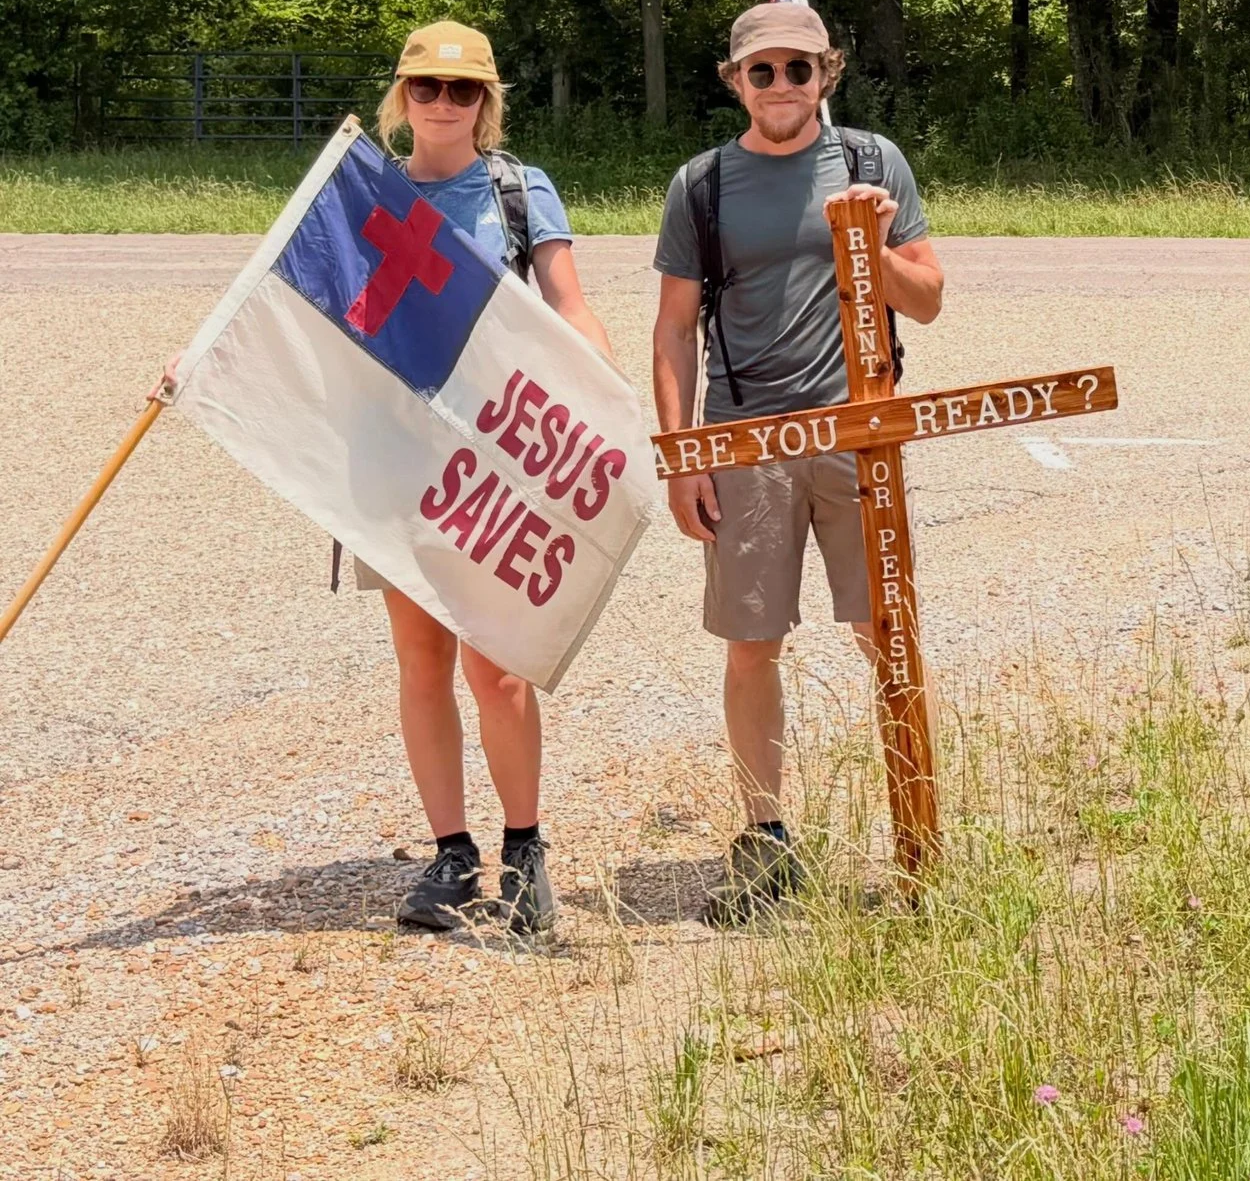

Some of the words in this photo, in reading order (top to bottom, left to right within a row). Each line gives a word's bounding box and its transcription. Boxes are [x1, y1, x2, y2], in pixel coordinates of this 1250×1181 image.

[847, 227, 880, 378] REPENT
[476, 369, 627, 521] JESUS
[750, 415, 839, 461] YOU
[911, 380, 1060, 436] READY
[871, 460, 893, 509] OR
[420, 447, 575, 607] SAVES
[879, 529, 911, 685] PERISH
